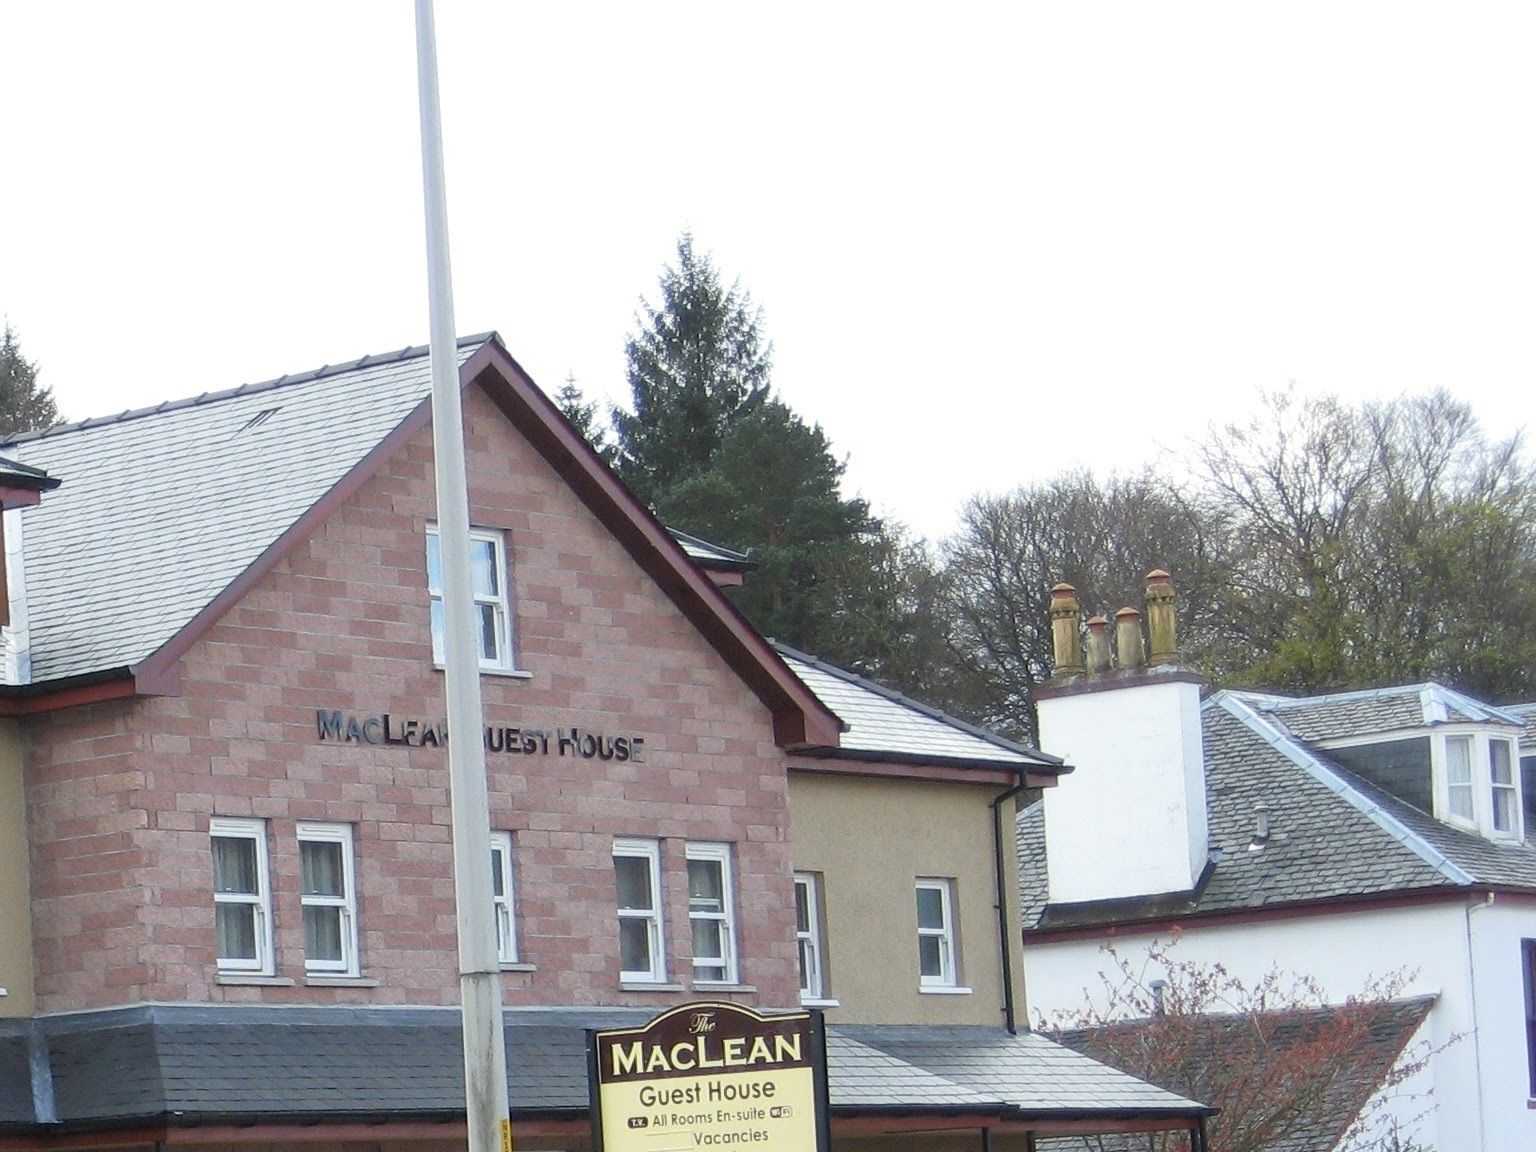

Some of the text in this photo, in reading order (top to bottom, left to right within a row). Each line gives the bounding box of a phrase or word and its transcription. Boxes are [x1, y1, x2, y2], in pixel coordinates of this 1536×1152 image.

[483, 727, 549, 756] UEST
[688, 1011, 717, 1035] The
[639, 1080, 776, 1107] Guest House
[652, 1115, 668, 1127] All
[671, 1112, 713, 1126] Rooms
[717, 1108, 766, 1122] En-suite
[694, 1128, 769, 1145] Vacancies
